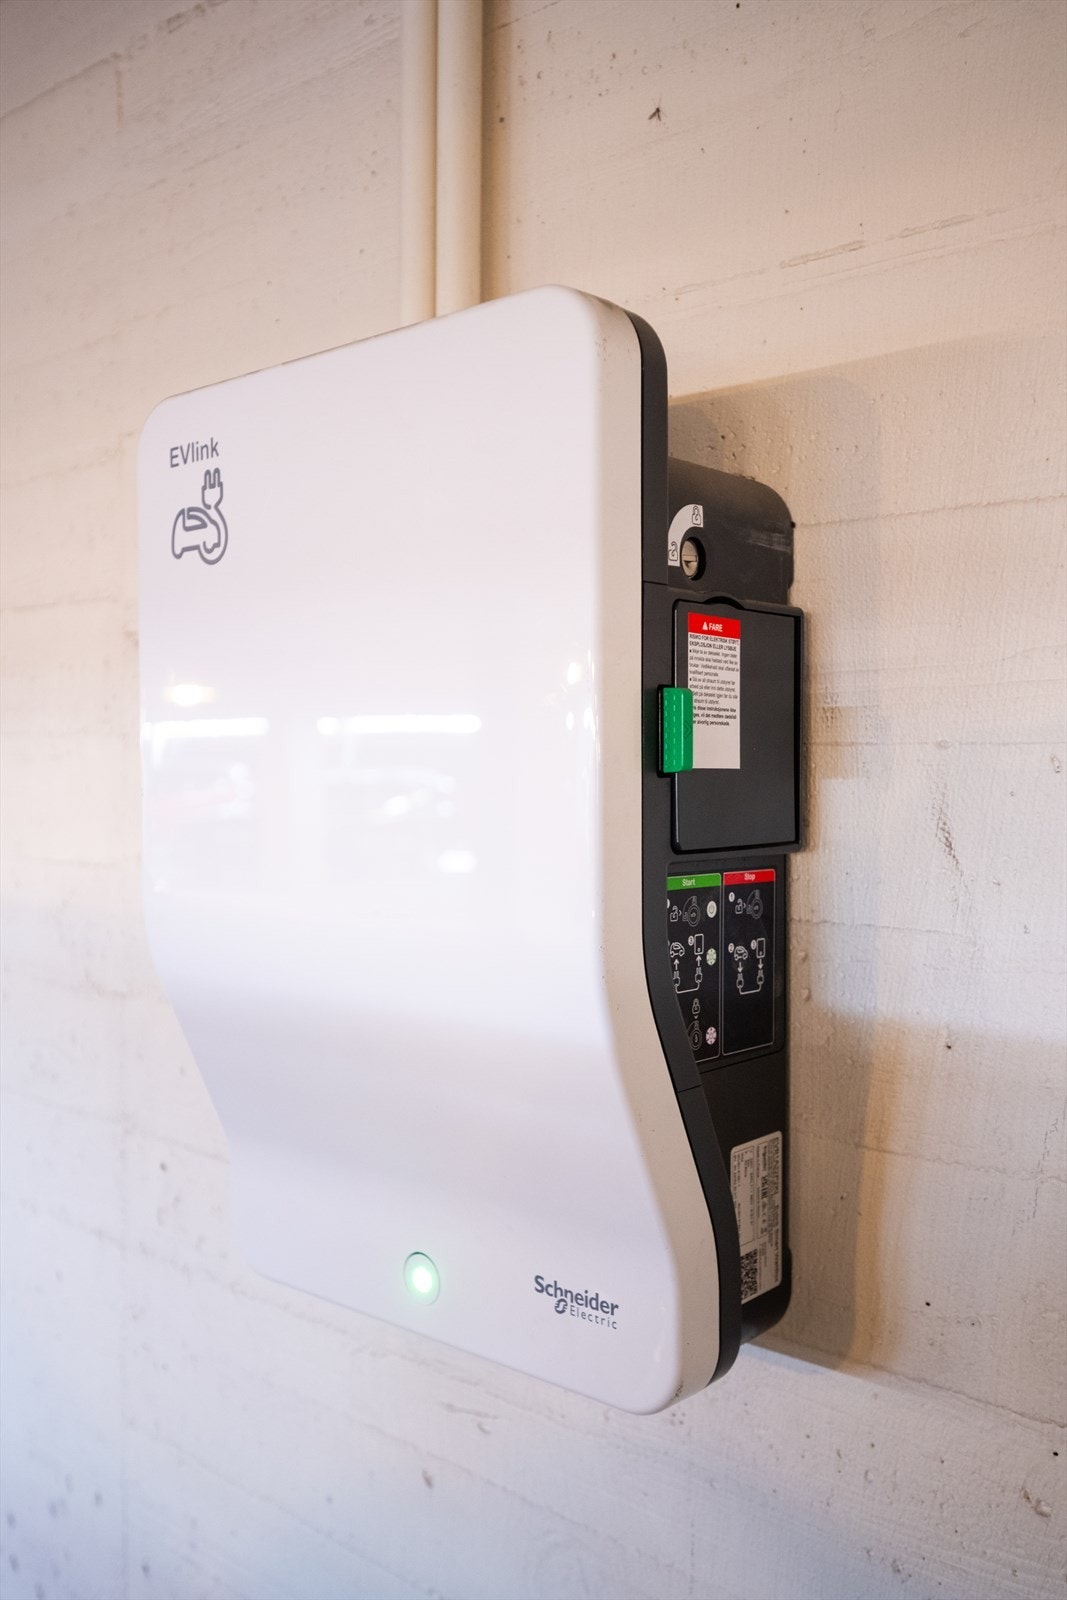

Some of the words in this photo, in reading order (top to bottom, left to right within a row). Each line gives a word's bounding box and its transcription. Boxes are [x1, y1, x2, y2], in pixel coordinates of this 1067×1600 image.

[170, 437, 220, 468] EVlink
[708, 622, 723, 632] FARE
[682, 878, 696, 887] Start
[744, 873, 755, 882] Stop
[534, 1274, 619, 1316] Schneider
[569, 1305, 617, 1330] Electric
